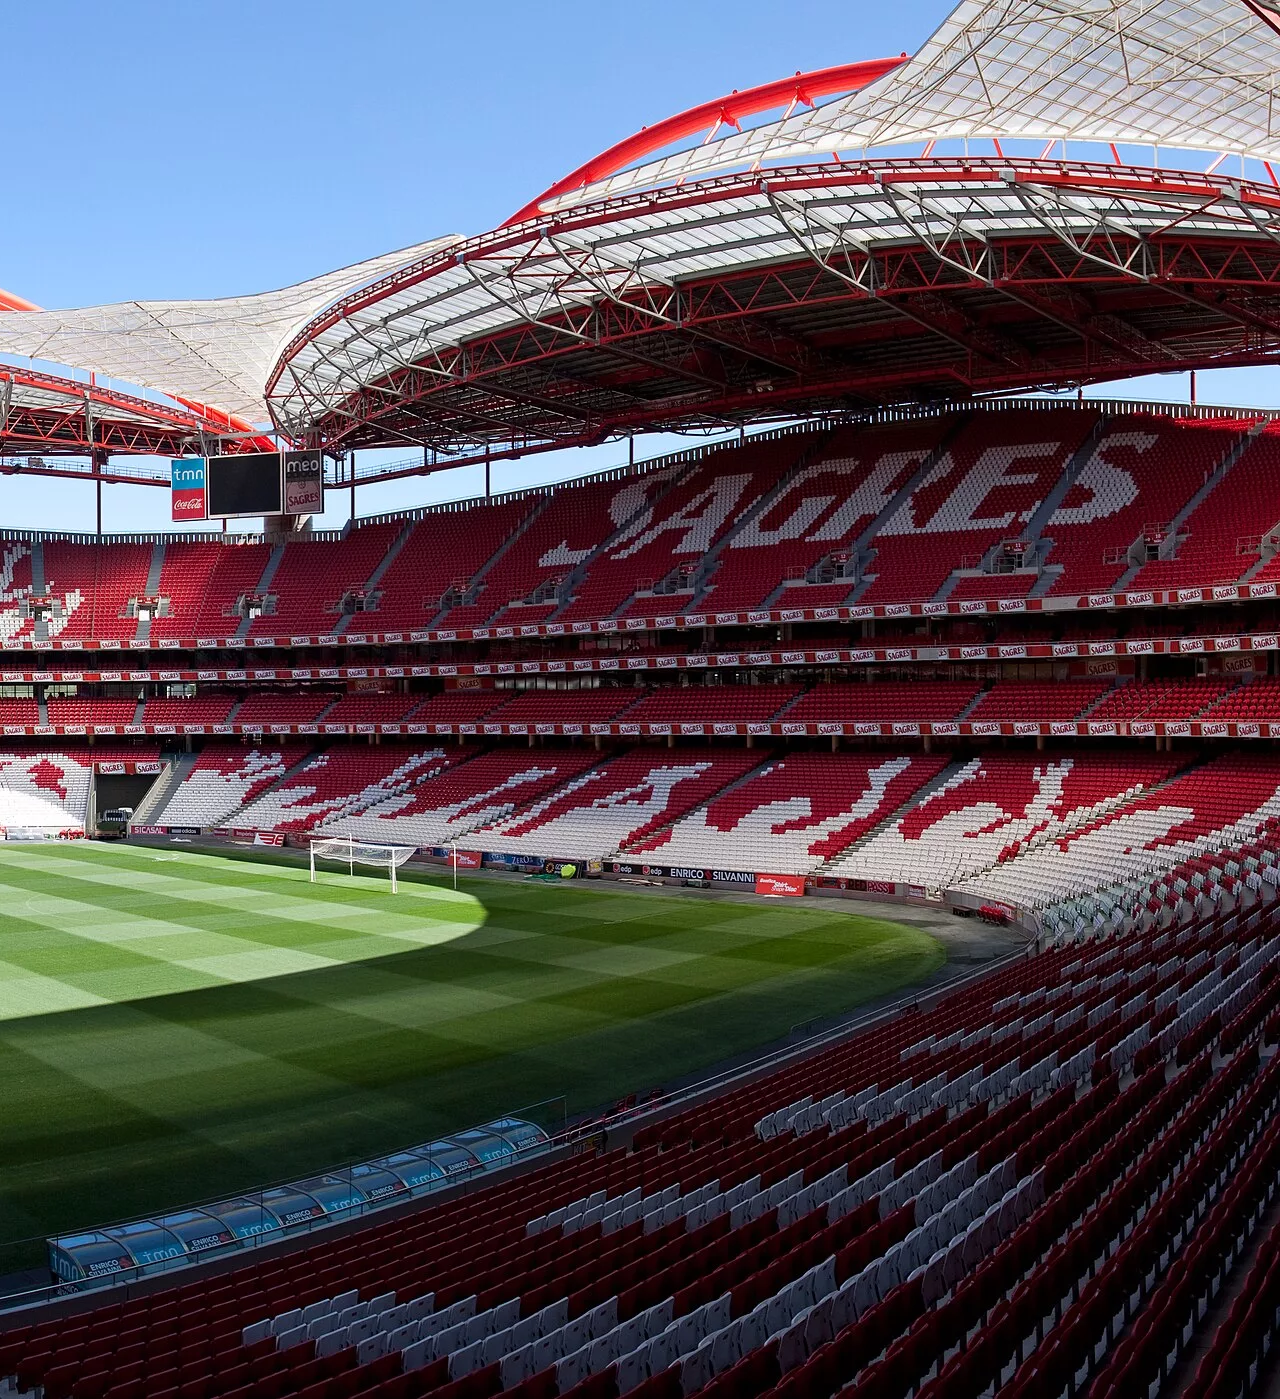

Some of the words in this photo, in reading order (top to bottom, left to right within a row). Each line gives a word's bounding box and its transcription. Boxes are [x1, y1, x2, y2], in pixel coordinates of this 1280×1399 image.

[287, 459, 320, 473] meo
[173, 467, 205, 482] tmn
[173, 498, 203, 511] Coca-Cola
[288, 491, 320, 507] SAGRES
[538, 430, 1159, 568] SAGRES
[1127, 593, 1152, 604] SAGRES
[961, 602, 985, 613] SAGRES
[782, 610, 803, 620] SAGRES
[548, 624, 565, 633] SAGRES
[291, 637, 310, 645] SAGRES
[1216, 639, 1239, 649] SAGRES
[817, 651, 838, 662] SAGRES
[1087, 662, 1117, 674] SAGRES
[1224, 659, 1252, 671] SAGRES
[356, 679, 381, 690] SAGRES
[325, 724, 345, 733] SAGRES
[783, 725, 806, 734] SAGRES
[1131, 724, 1154, 734] SAGRES
[100, 763, 123, 773] SAGRES
[137, 763, 160, 773] SAGRES
[134, 826, 163, 834] SICASAL
[620, 864, 632, 873] edp
[650, 867, 662, 876] edp
[670, 868, 704, 879] ENRICO
[712, 870, 755, 883] SILVANNI
[867, 881, 889, 894] PASS
[286, 1209, 311, 1222] ENRICO
[241, 1222, 273, 1239] tmn
[192, 1234, 219, 1247] ENRICO
[143, 1246, 178, 1262] tmn
[52, 1250, 79, 1281] tmn
[89, 1258, 119, 1272] ENRICO
